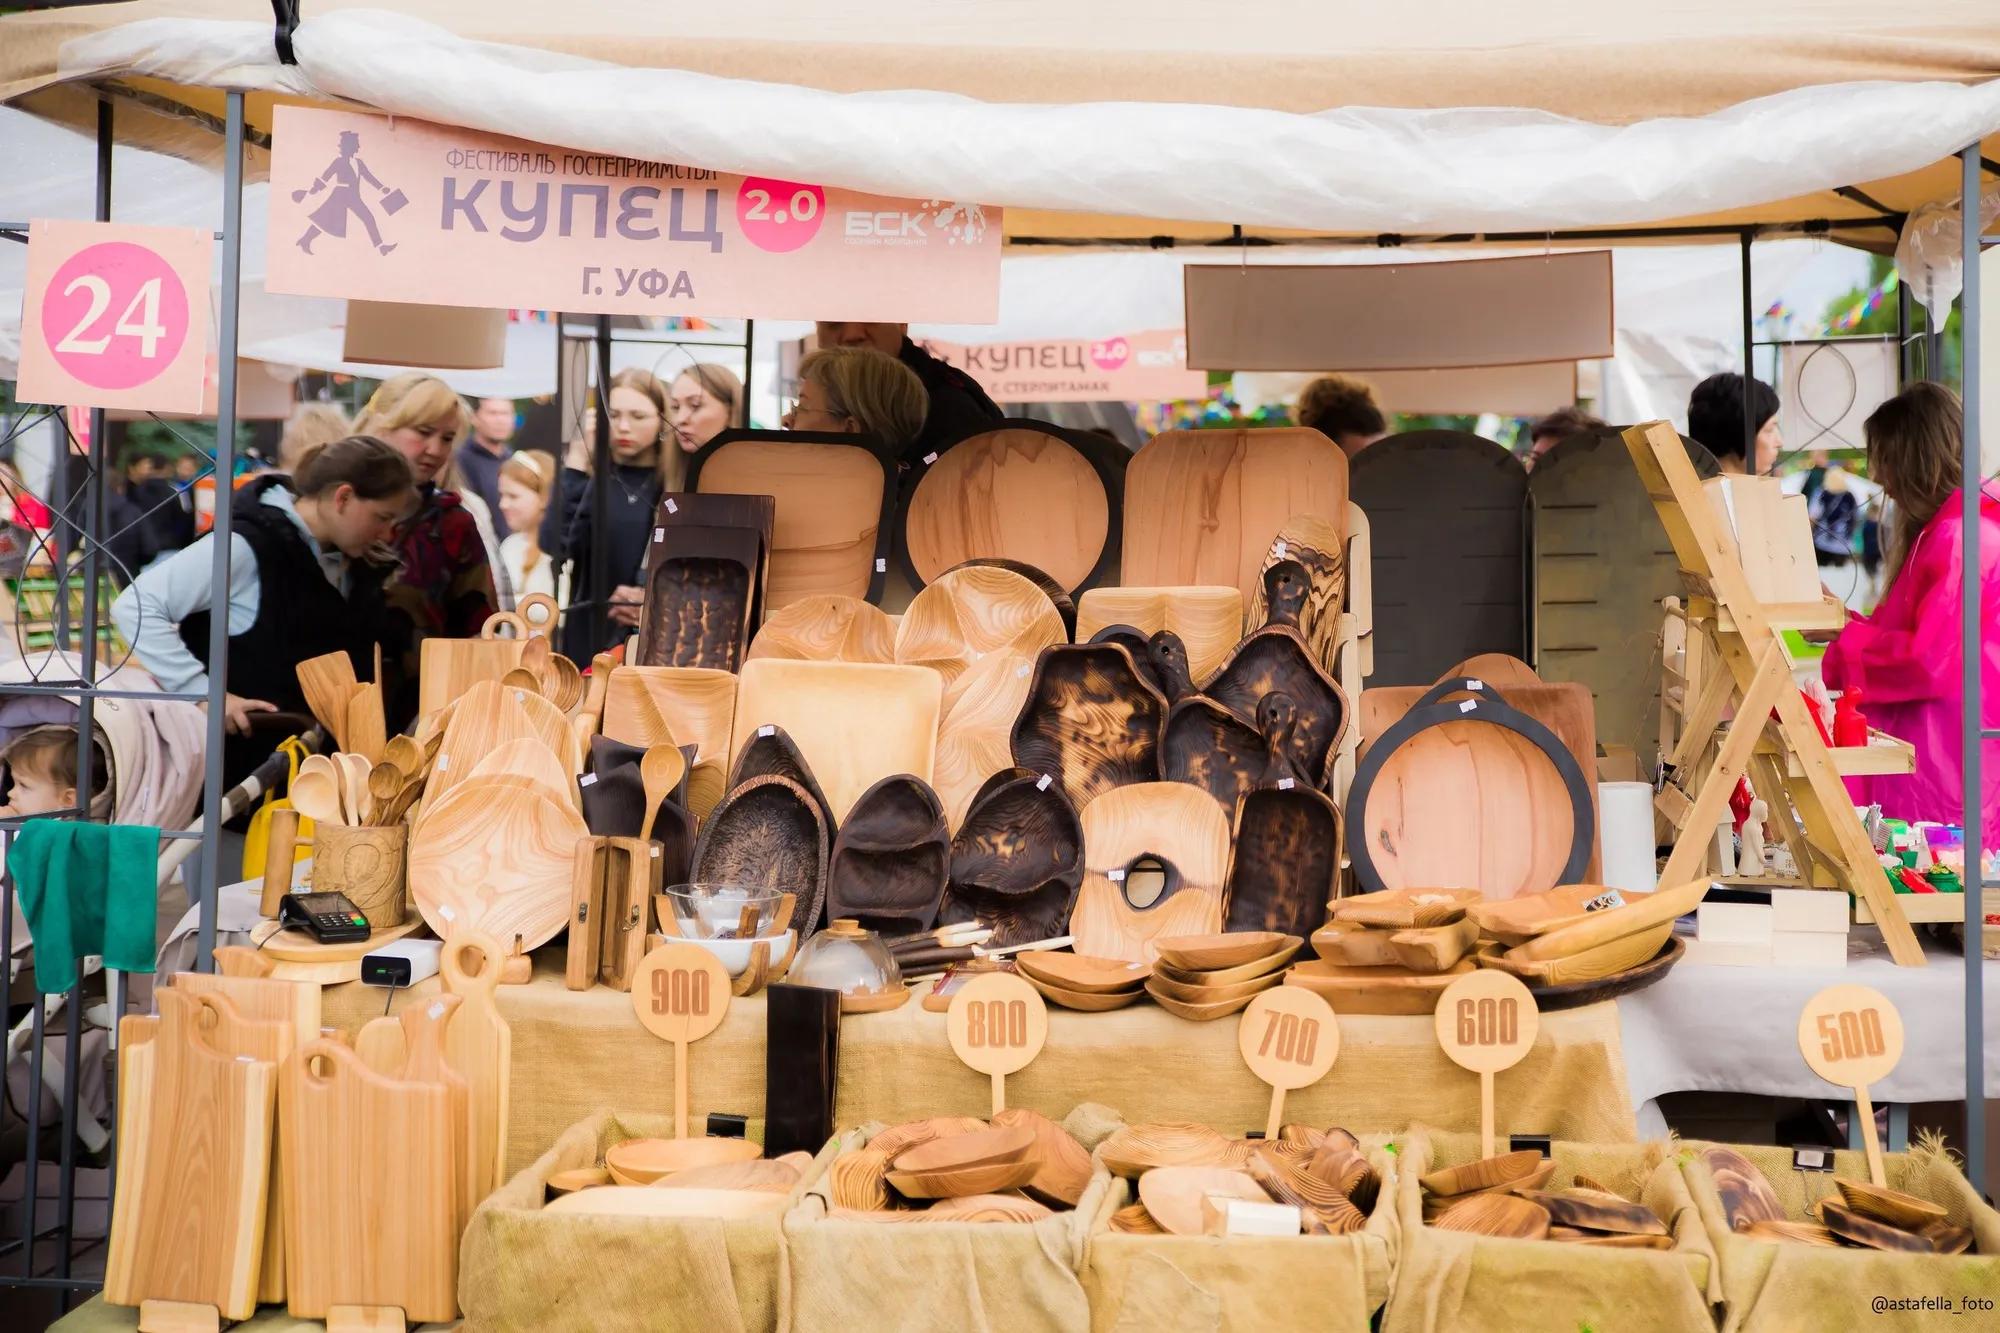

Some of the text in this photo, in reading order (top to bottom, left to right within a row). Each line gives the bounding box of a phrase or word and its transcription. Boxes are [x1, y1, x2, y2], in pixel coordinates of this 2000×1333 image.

[446, 148, 556, 174] ФЕСТИВАЛЬ
[441, 177, 818, 253] КУПЕЦ 2.0
[844, 211, 928, 236] БСК
[582, 267, 695, 299] Г. УФА
[55, 274, 167, 359] 24
[965, 345, 1086, 372] КУПЕЦ
[651, 969, 710, 1016] 900
[967, 1000, 1028, 1048] 800
[1258, 1009, 1320, 1067] 700
[1457, 998, 1519, 1046] 600
[1816, 1007, 1886, 1063] 500
